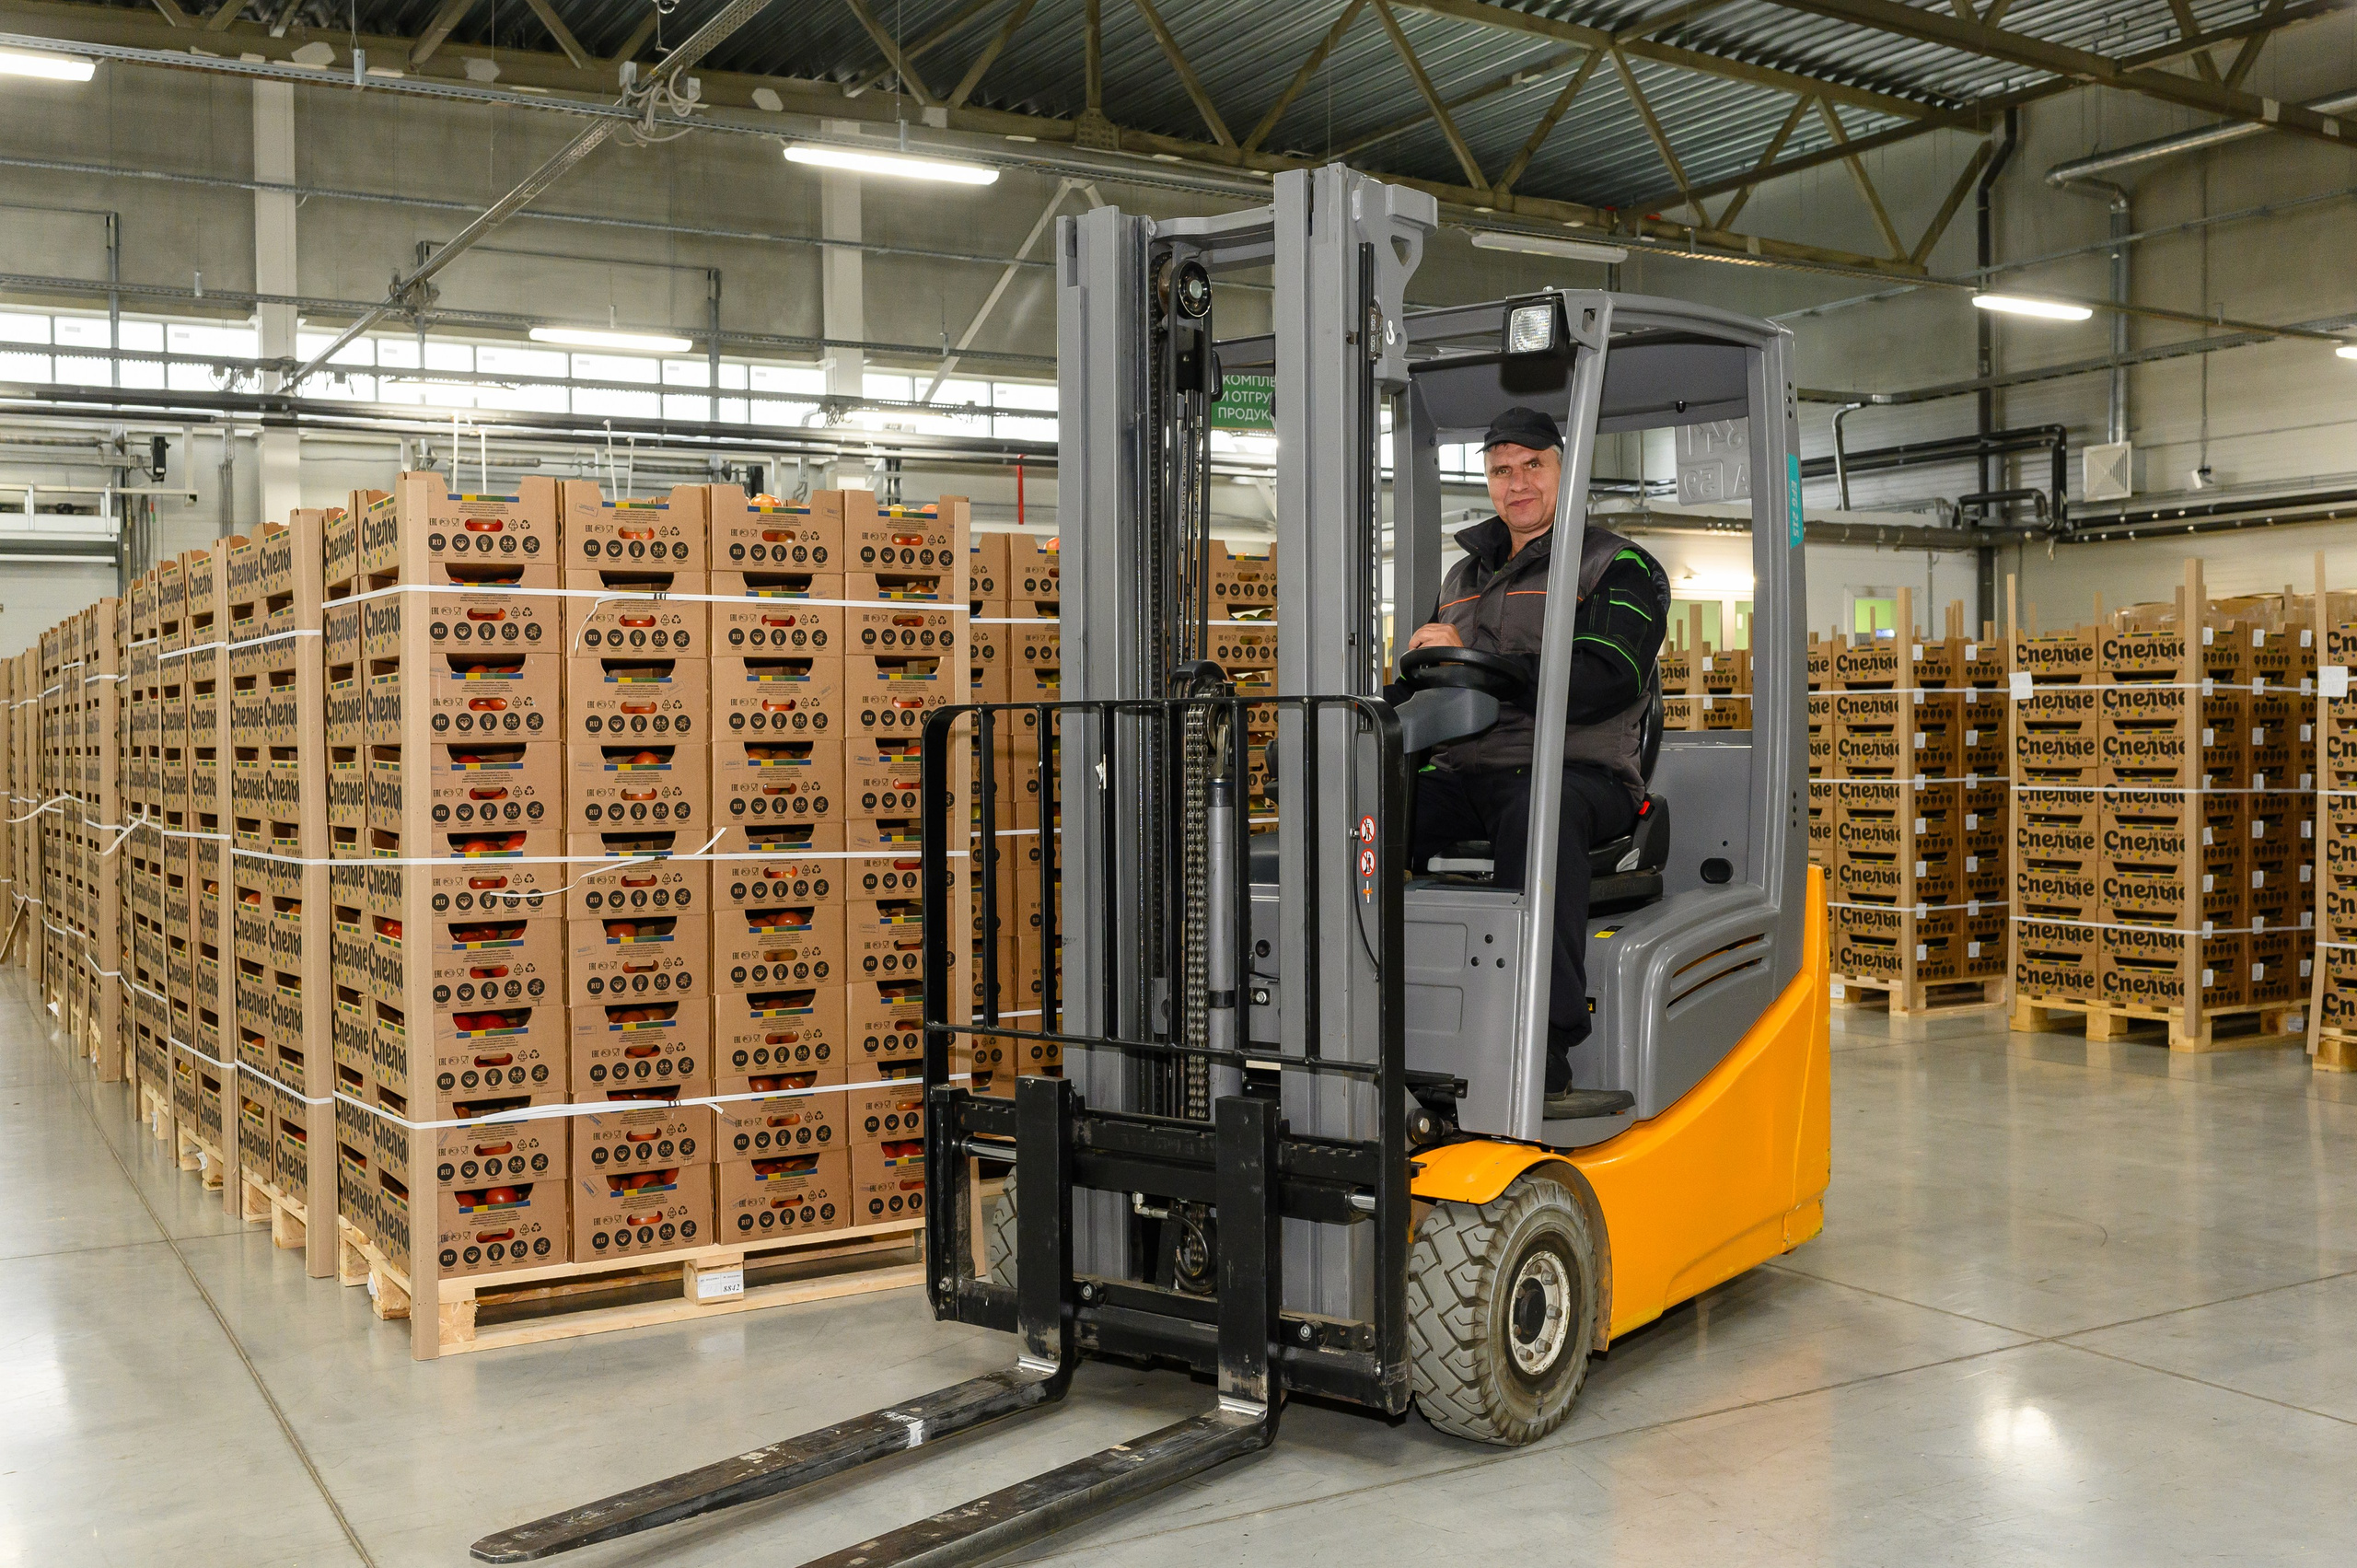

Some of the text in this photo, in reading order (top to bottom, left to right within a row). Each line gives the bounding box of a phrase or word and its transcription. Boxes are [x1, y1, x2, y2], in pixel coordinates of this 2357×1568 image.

[324, 528, 355, 567] Спелые
[363, 516, 398, 552] Спелы
[260, 546, 292, 577] Спелы
[324, 613, 357, 645] Спелые
[365, 603, 401, 638] Спелы
[2017, 643, 2094, 663] Спелые
[264, 696, 297, 727] Спелы
[326, 693, 361, 726] Спелые
[366, 688, 401, 725] Спелы
[2017, 736, 2095, 756] Спелые
[265, 770, 299, 802] Спелы
[328, 772, 364, 807] Спелые
[368, 771, 402, 810] Спелы
[2017, 828, 2095, 849] Спелые
[368, 865, 402, 898] Спелы
[2017, 873, 2095, 896] Спелые
[268, 920, 301, 957] Спелы
[2017, 921, 2094, 943] Спелые
[331, 931, 368, 971] Спелые
[368, 942, 403, 989] Спелы
[2016, 963, 2095, 989] Спелые
[271, 993, 303, 1034] Спелы
[332, 1009, 369, 1054] Спелые
[372, 1028, 407, 1076] Спелы
[373, 1113, 409, 1164] Спелы
[276, 1139, 308, 1187] Спелы
[339, 1163, 374, 1219] Спелые
[375, 1194, 410, 1252] Спелы
[723, 1283, 740, 1293] 8842
